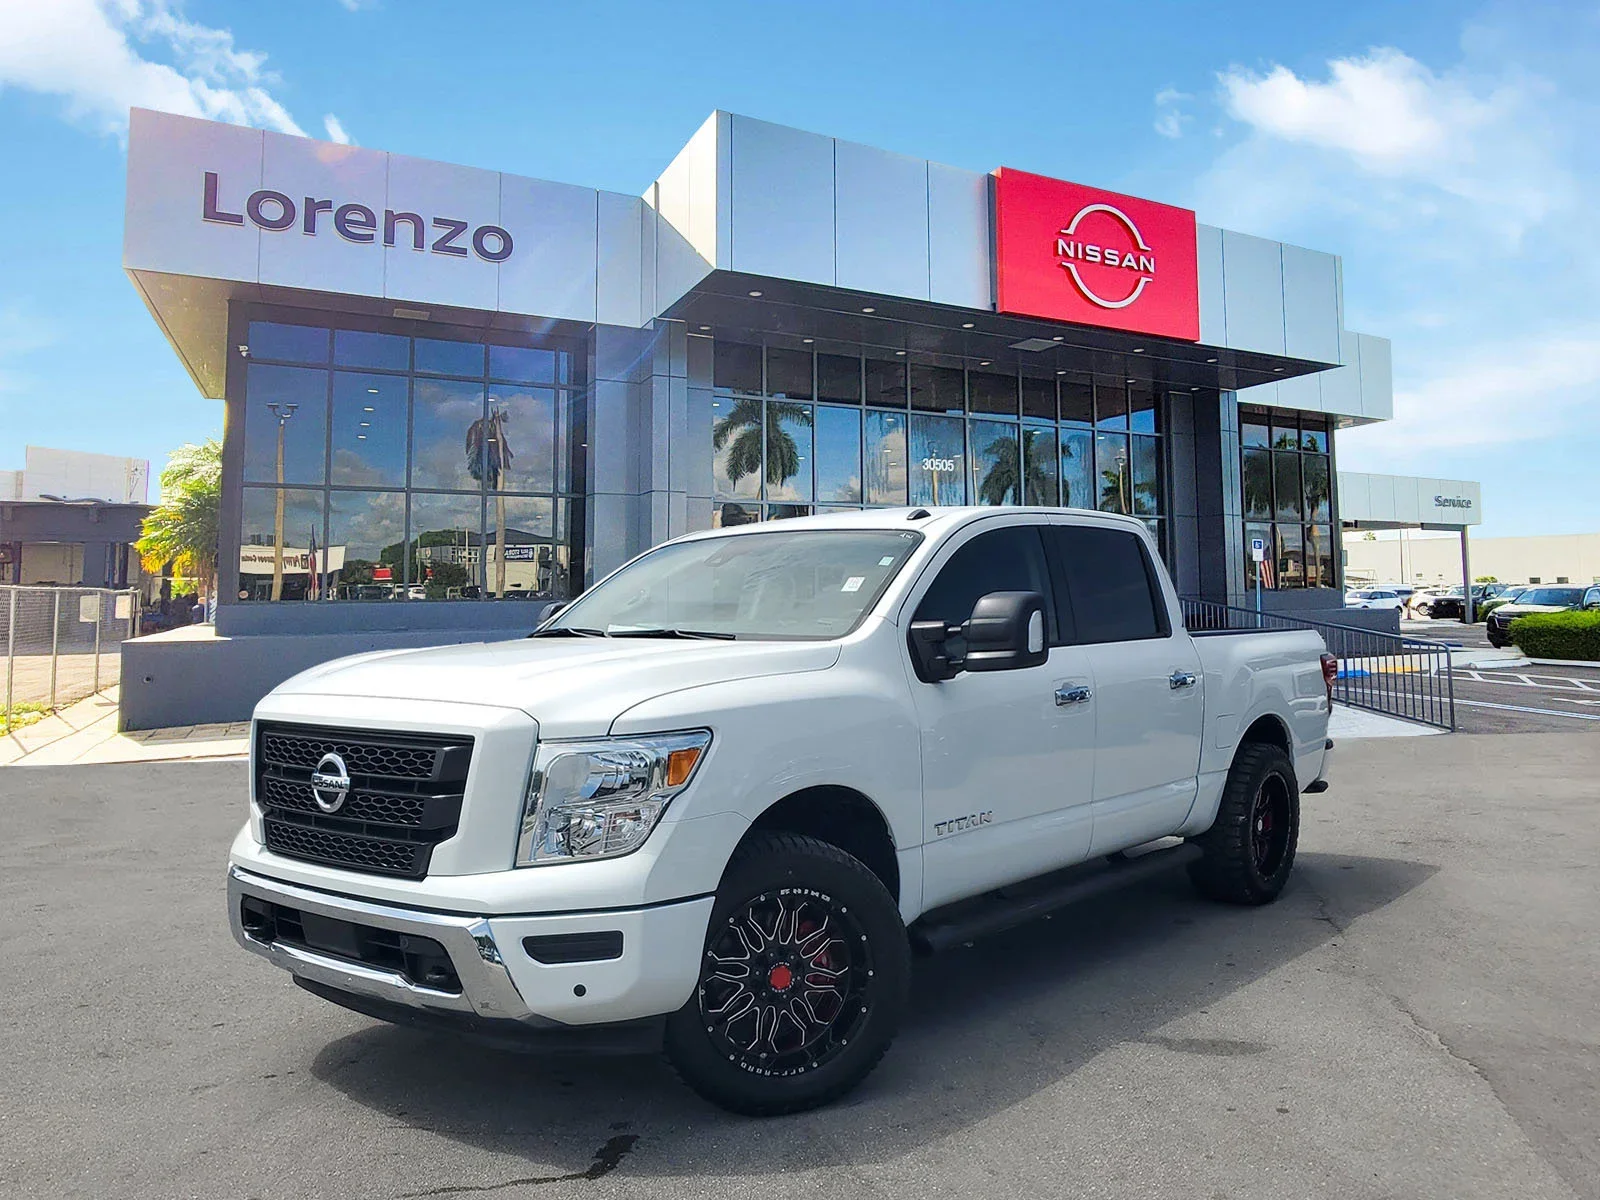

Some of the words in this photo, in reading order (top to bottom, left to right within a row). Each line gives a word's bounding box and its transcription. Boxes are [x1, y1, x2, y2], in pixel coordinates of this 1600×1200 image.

[202, 171, 514, 262] Lorenzo
[1057, 238, 1155, 273] NISSAN
[922, 458, 954, 471] 30505
[1433, 495, 1472, 508] Service
[934, 810, 993, 836] TITAN
